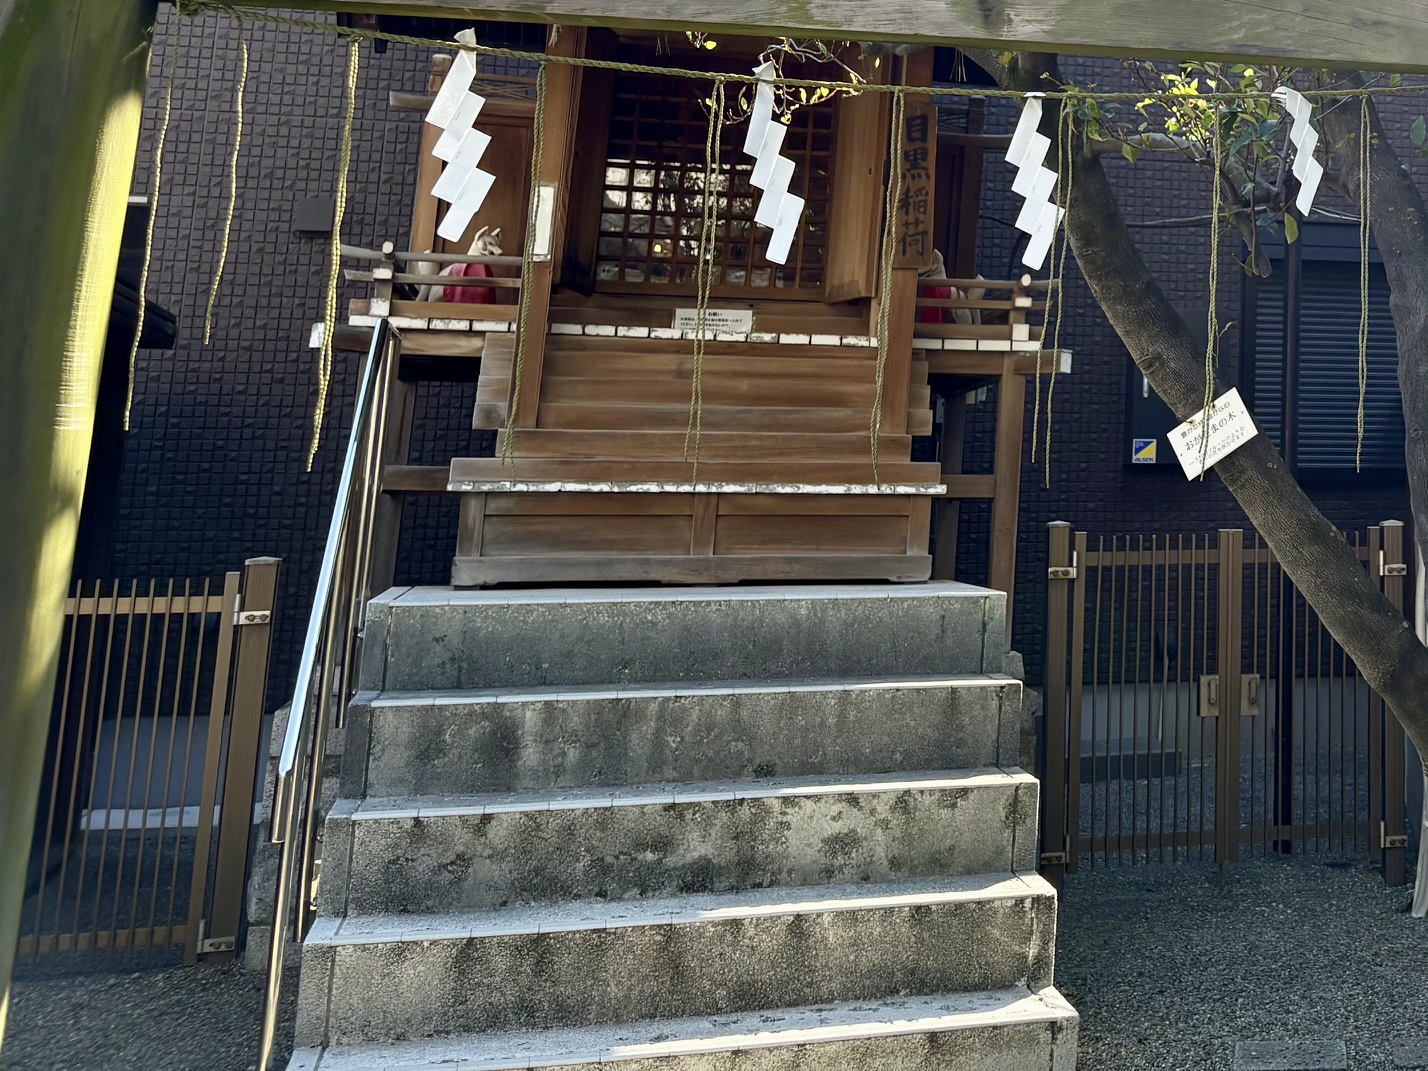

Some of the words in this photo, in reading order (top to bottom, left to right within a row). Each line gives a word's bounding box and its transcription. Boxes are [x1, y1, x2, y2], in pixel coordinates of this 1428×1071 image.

[898, 114, 931, 260] 目黒稲荷
[1185, 411, 1237, 450] おがまの木
